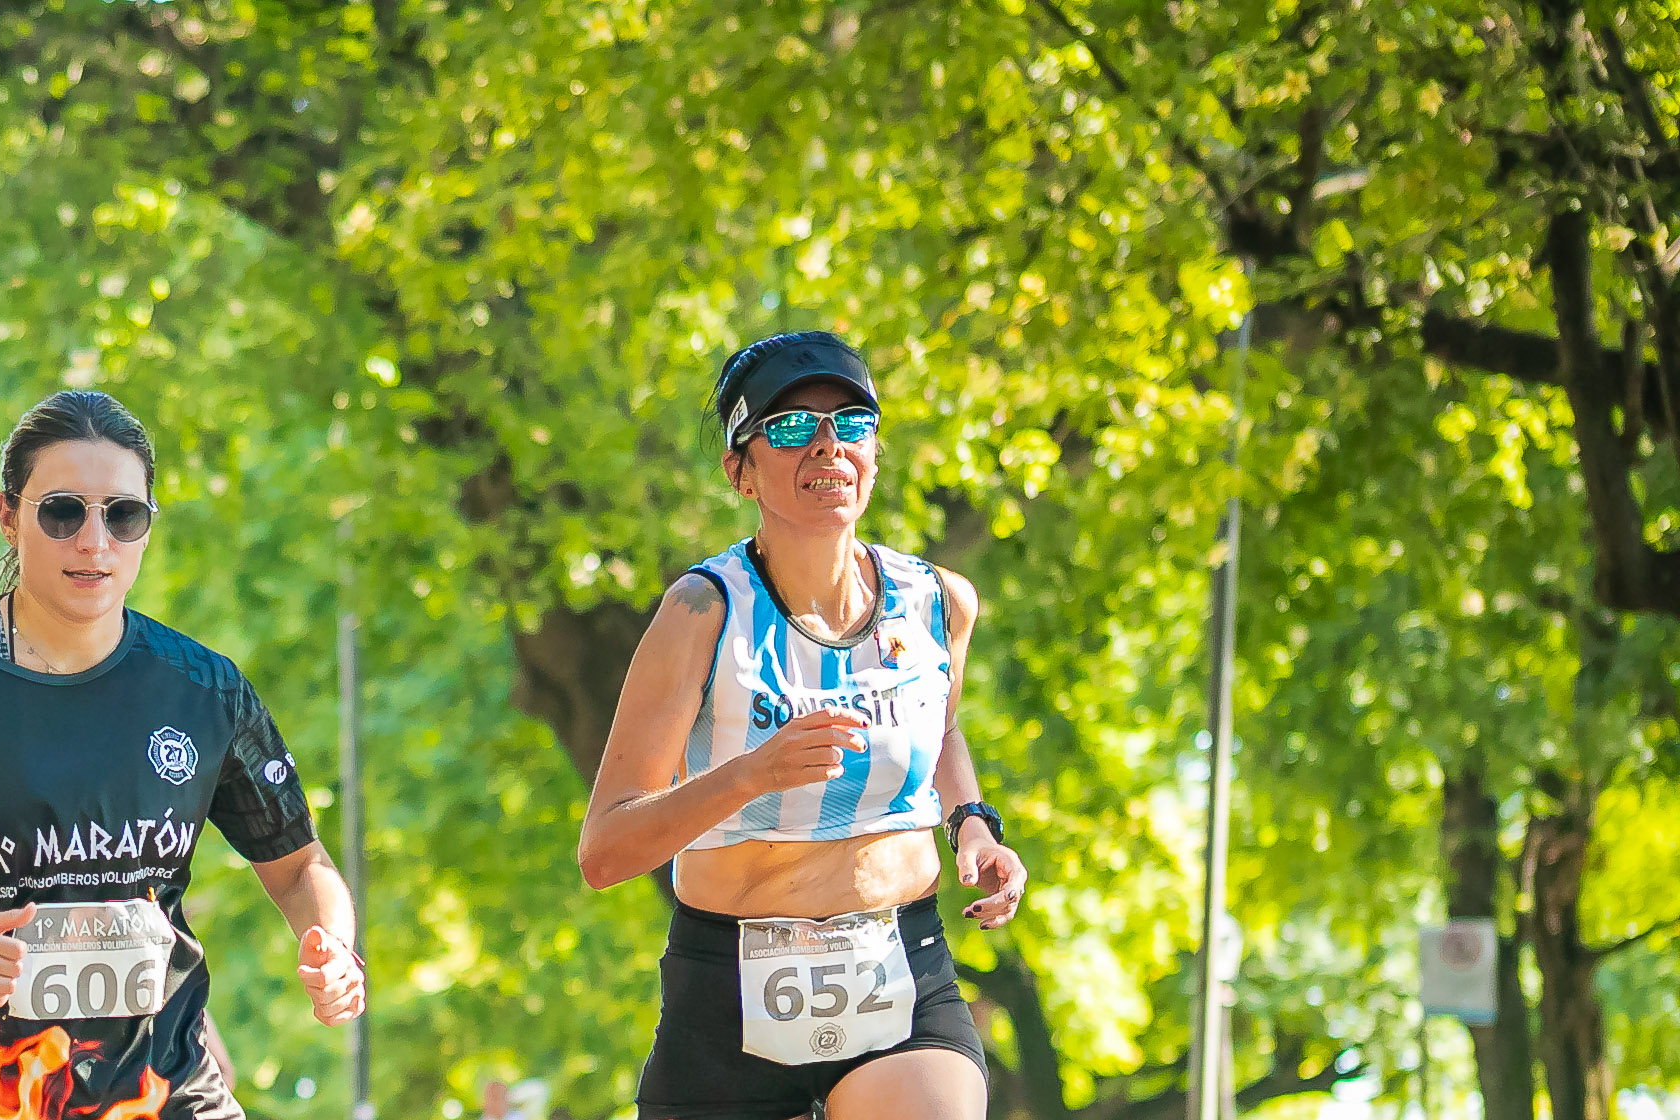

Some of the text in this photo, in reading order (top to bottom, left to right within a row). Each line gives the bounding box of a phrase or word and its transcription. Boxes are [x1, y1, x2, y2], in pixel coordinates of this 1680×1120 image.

[33, 807, 195, 867] MARATÓN
[60, 908, 158, 938] MARATÓN
[26, 941, 61, 953] OCIACIÓN
[61, 939, 102, 951] BOMBEROS
[749, 940, 855, 959] ASOCIACIÓN BOMBEROS VOLUN
[31, 959, 156, 1020] 606
[763, 959, 894, 1022] 652
[820, 1032, 837, 1047] 27
